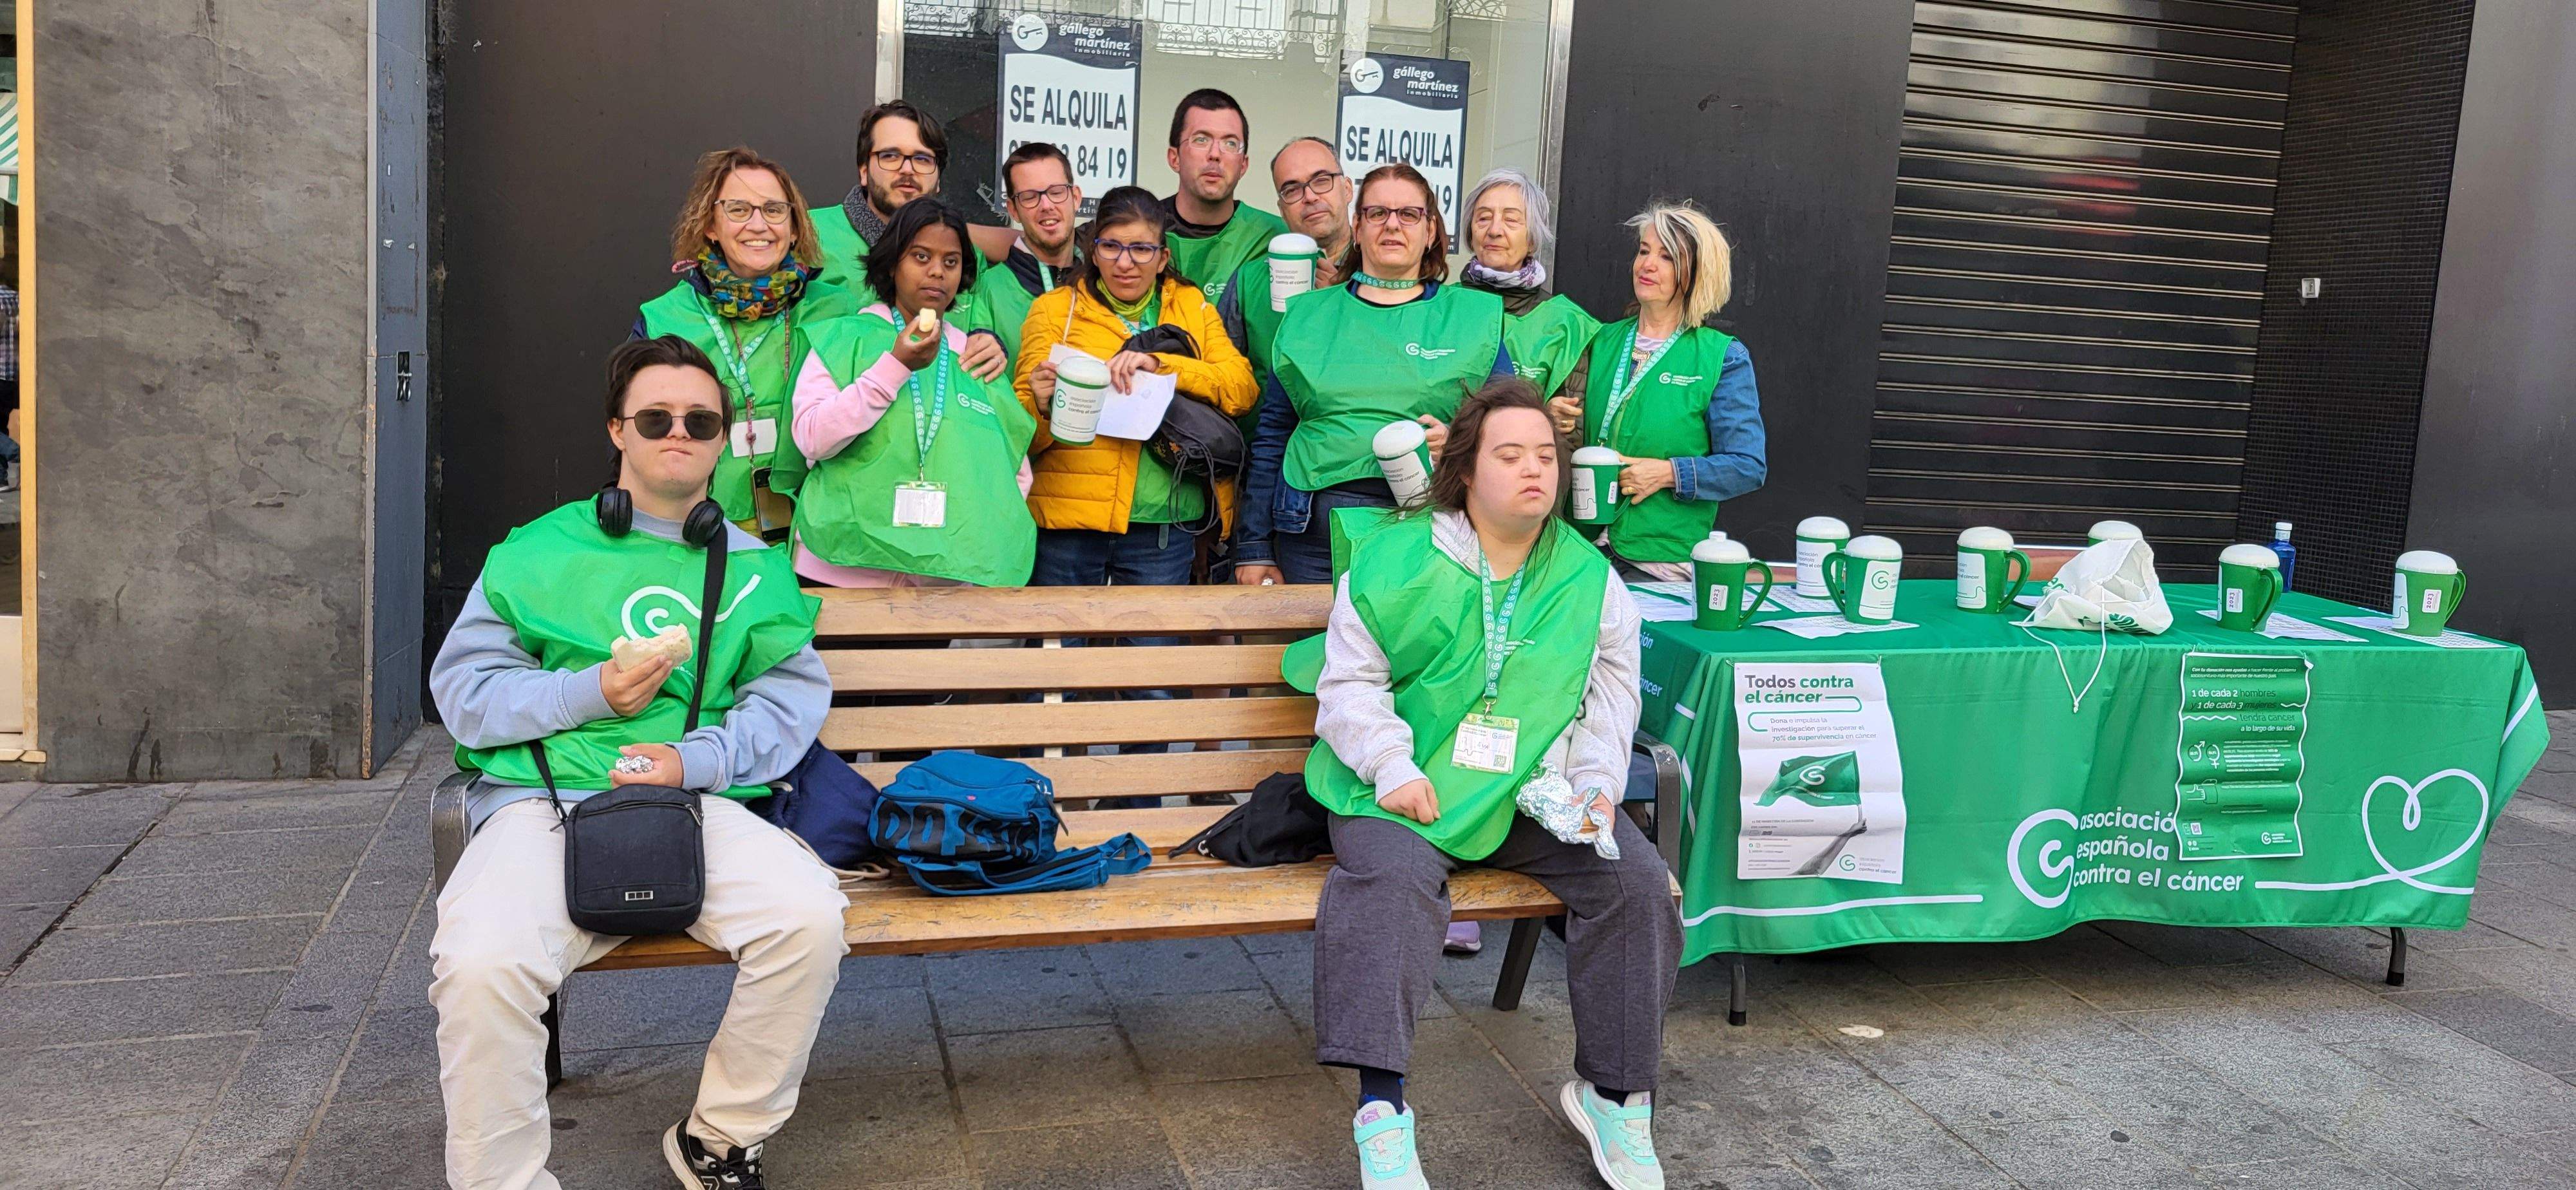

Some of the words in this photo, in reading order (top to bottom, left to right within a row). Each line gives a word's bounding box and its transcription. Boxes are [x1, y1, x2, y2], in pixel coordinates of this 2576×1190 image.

[1058, 23, 1104, 39] gállego
[1074, 37, 1131, 52] martínez
[1074, 46, 1131, 57] inmobiliaria
[1392, 66, 1435, 81] gállego
[1407, 80, 1459, 93] martínez
[1406, 90, 1459, 99] inmobiliaria
[1010, 84, 1036, 124] SE
[1041, 88, 1128, 131] ALQUILA
[1345, 126, 1370, 162] SE
[1374, 128, 1453, 169] ALQUILA
[1076, 145, 1099, 178] 84
[1108, 147, 1127, 179] 19
[2426, 593, 2434, 609] 2023
[1745, 674, 1796, 688] Todos
[1799, 675, 1854, 688] contra
[1745, 690, 1761, 703] el
[1764, 690, 1823, 703] cáncer
[2198, 688, 2210, 697] de
[2211, 688, 2231, 697] cada
[2240, 688, 2276, 697] hombres
[2191, 701, 2197, 711] y
[2203, 701, 2215, 709] de
[2216, 701, 2236, 709] cada
[2244, 701, 2278, 710] mujeres
[2239, 712, 2267, 722] tendrá
[1771, 725, 1815, 733] investigación
[2252, 725, 2267, 733] largo
[1797, 733, 1844, 742] supervivencia
[2079, 806, 2175, 833] asociació
[2076, 835, 2170, 862] española
[2072, 863, 2131, 888] contra
[2137, 867, 2161, 887] el
[2167, 870, 2244, 892] cáncer
